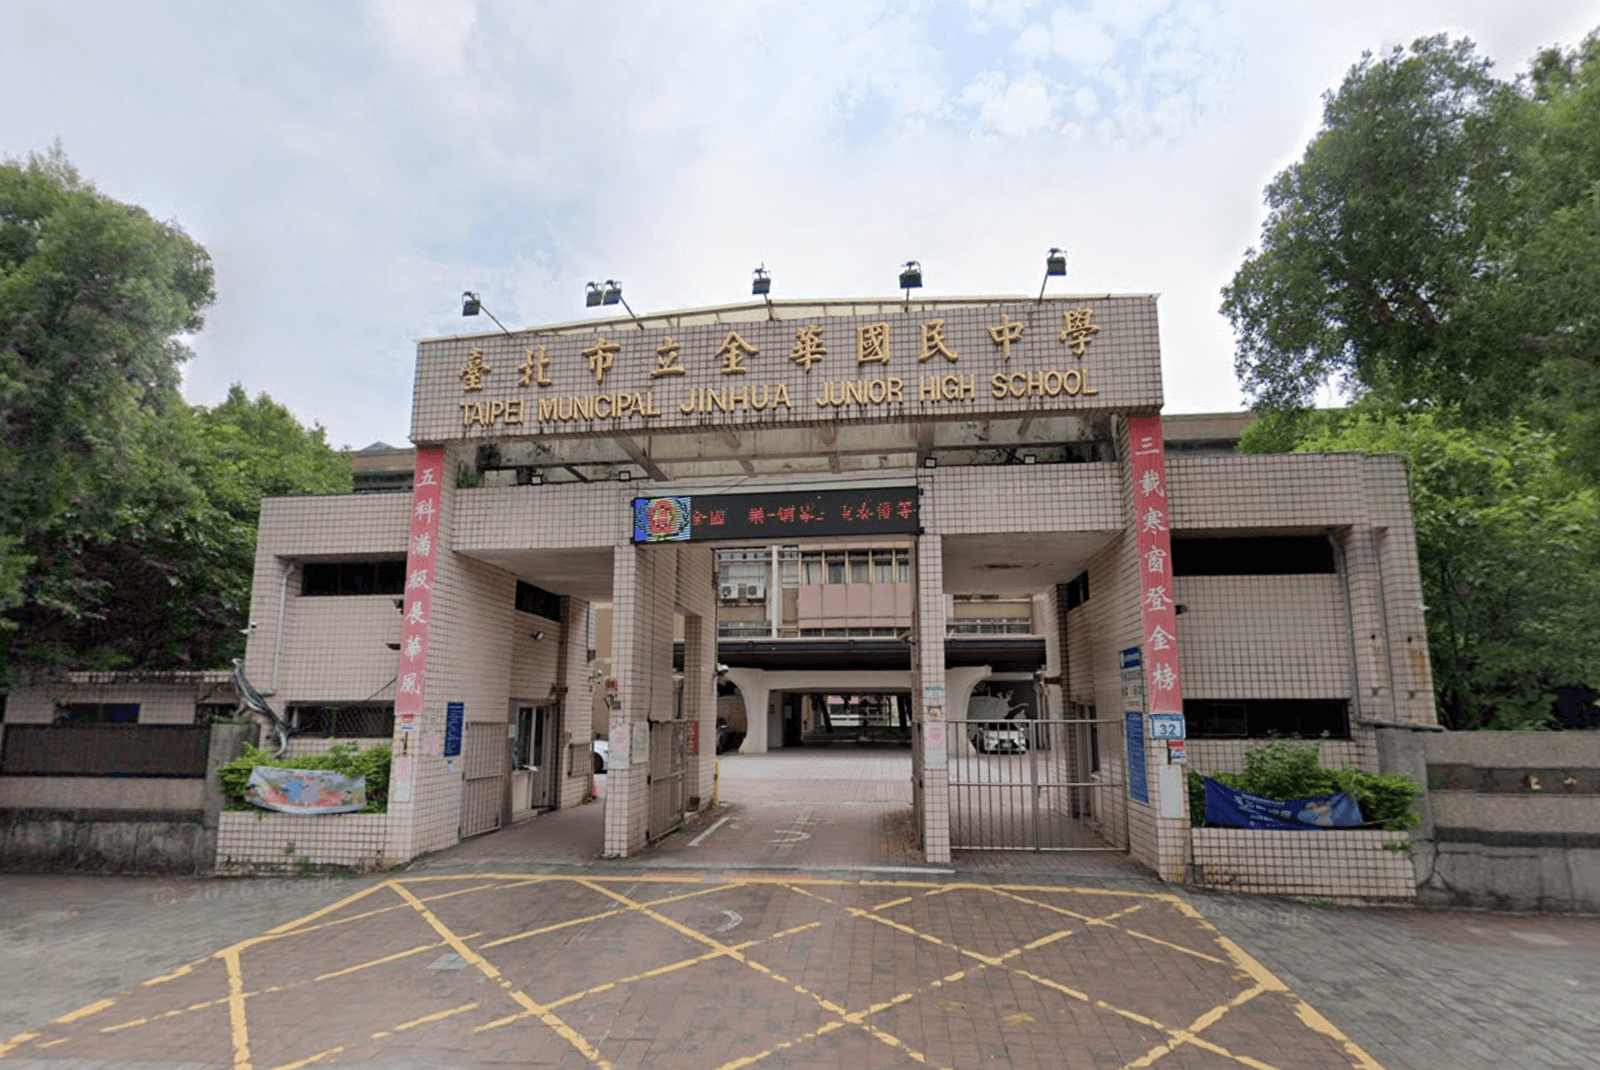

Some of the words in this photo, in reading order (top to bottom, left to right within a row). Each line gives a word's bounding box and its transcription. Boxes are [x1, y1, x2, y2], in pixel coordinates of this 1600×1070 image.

[459, 307, 1100, 392] 臺北市立金華國民中學
[459, 399, 526, 427] TAIPEI
[538, 391, 662, 423] MUNICIPAL
[679, 382, 792, 414] JINHUA
[816, 376, 904, 408] JUNIOR
[919, 373, 976, 402] HIGH
[991, 368, 1099, 399] SCHOOL
[1136, 436, 1178, 692] 三載寒窗登金榜
[1159, 723, 1177, 737] 32
